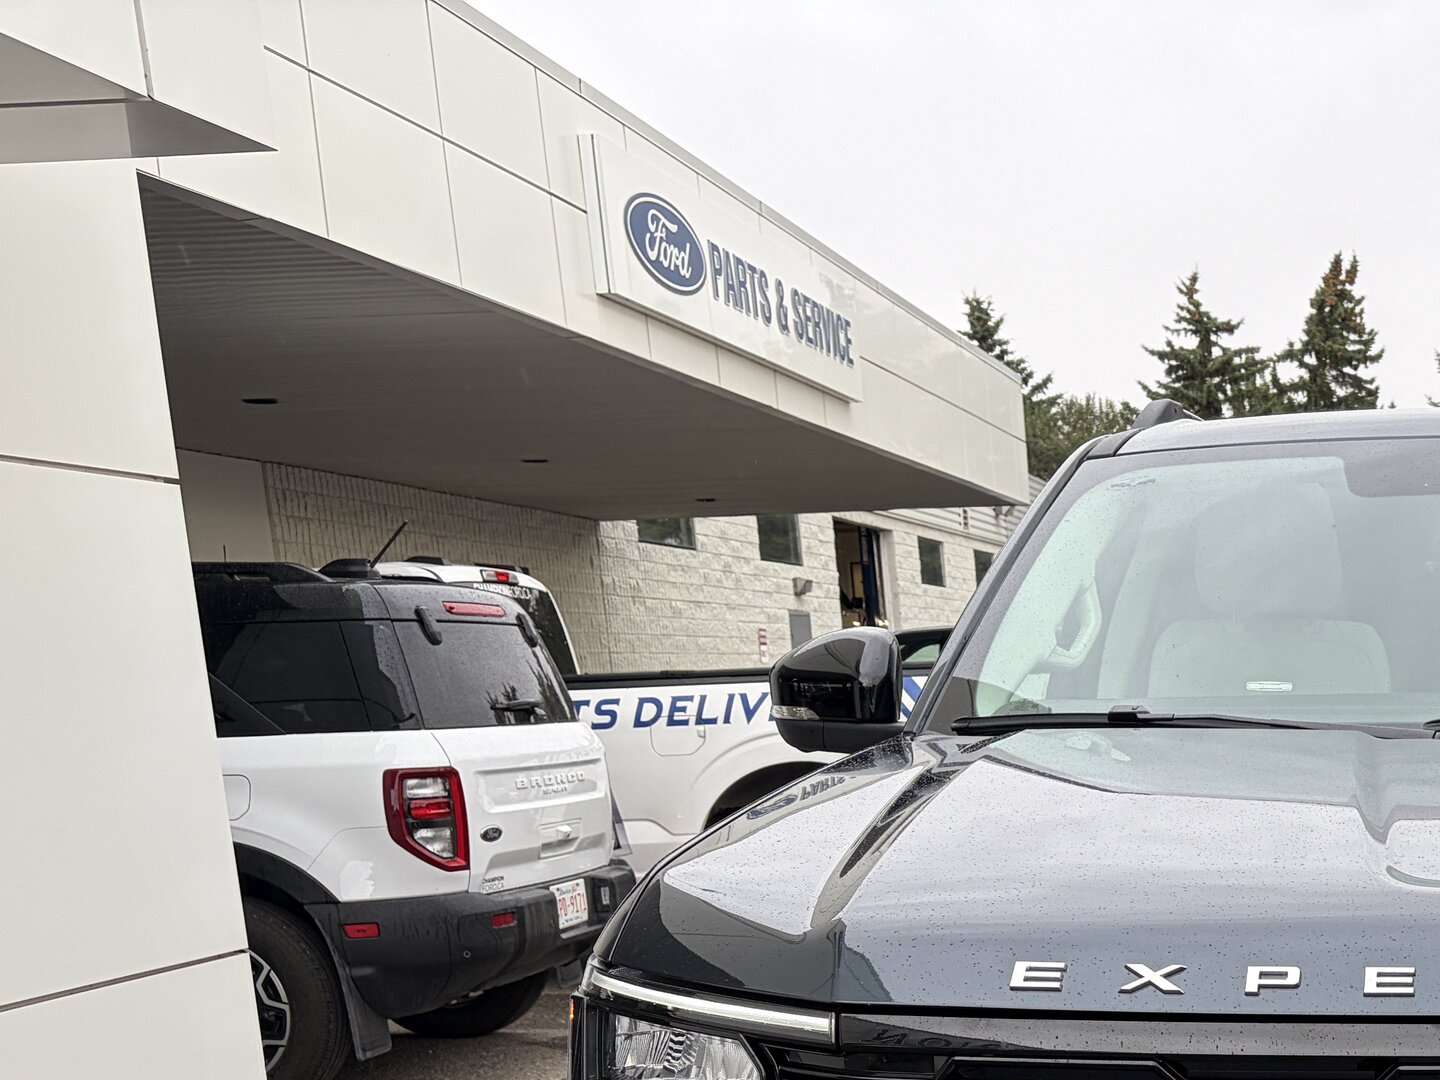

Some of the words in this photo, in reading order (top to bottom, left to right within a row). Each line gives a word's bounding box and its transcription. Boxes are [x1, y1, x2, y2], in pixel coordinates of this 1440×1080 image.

[645, 208, 692, 279] Ford
[707, 239, 772, 327] PARTS
[774, 277, 791, 337] &
[790, 288, 855, 368] SERVICE
[632, 692, 775, 729] DELIV
[515, 771, 585, 789] BRONCO
